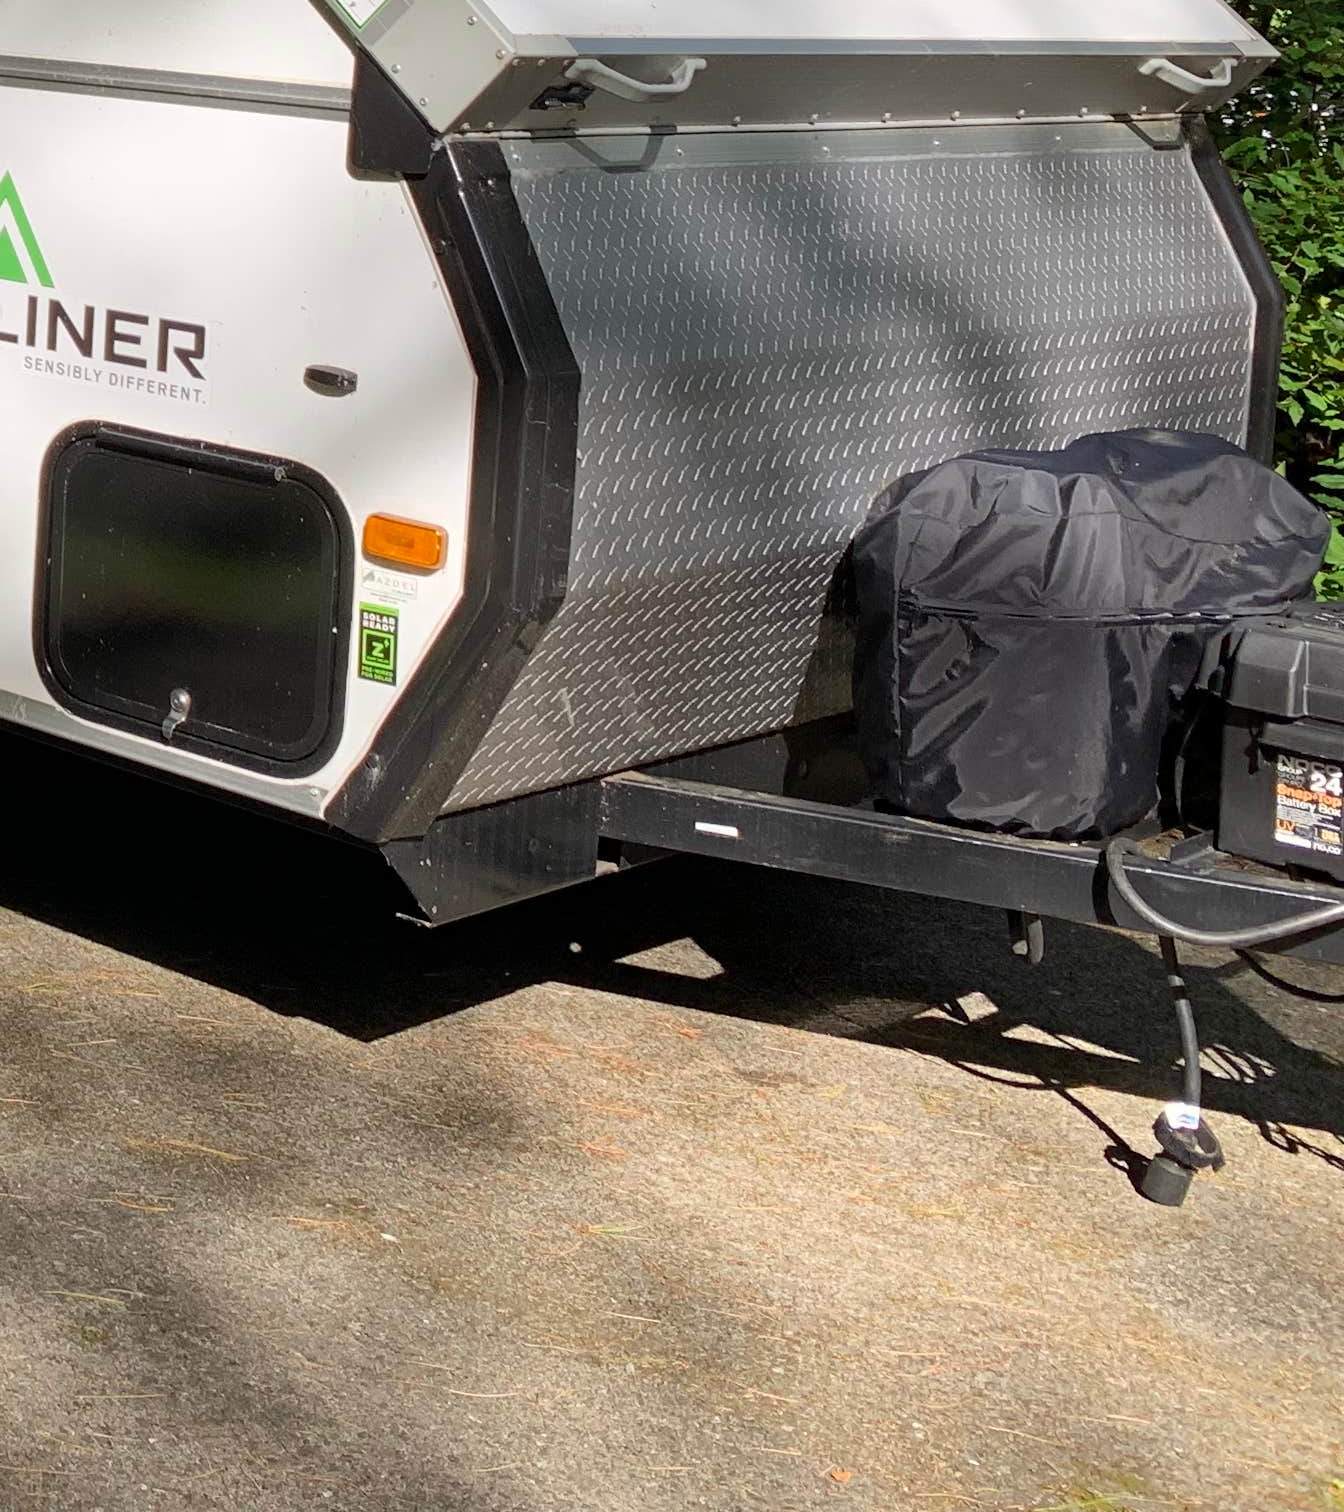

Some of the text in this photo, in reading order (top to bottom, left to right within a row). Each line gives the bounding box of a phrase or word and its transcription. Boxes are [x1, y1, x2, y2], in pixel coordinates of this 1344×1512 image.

[23, 356, 207, 404] SENSIBLY DIFFERENT.
[363, 612, 395, 625] SOLAR
[363, 620, 395, 632] READY
[1310, 772, 1343, 796] 24
[1277, 795, 1342, 817] Battery Box
[1276, 819, 1295, 831] UV
